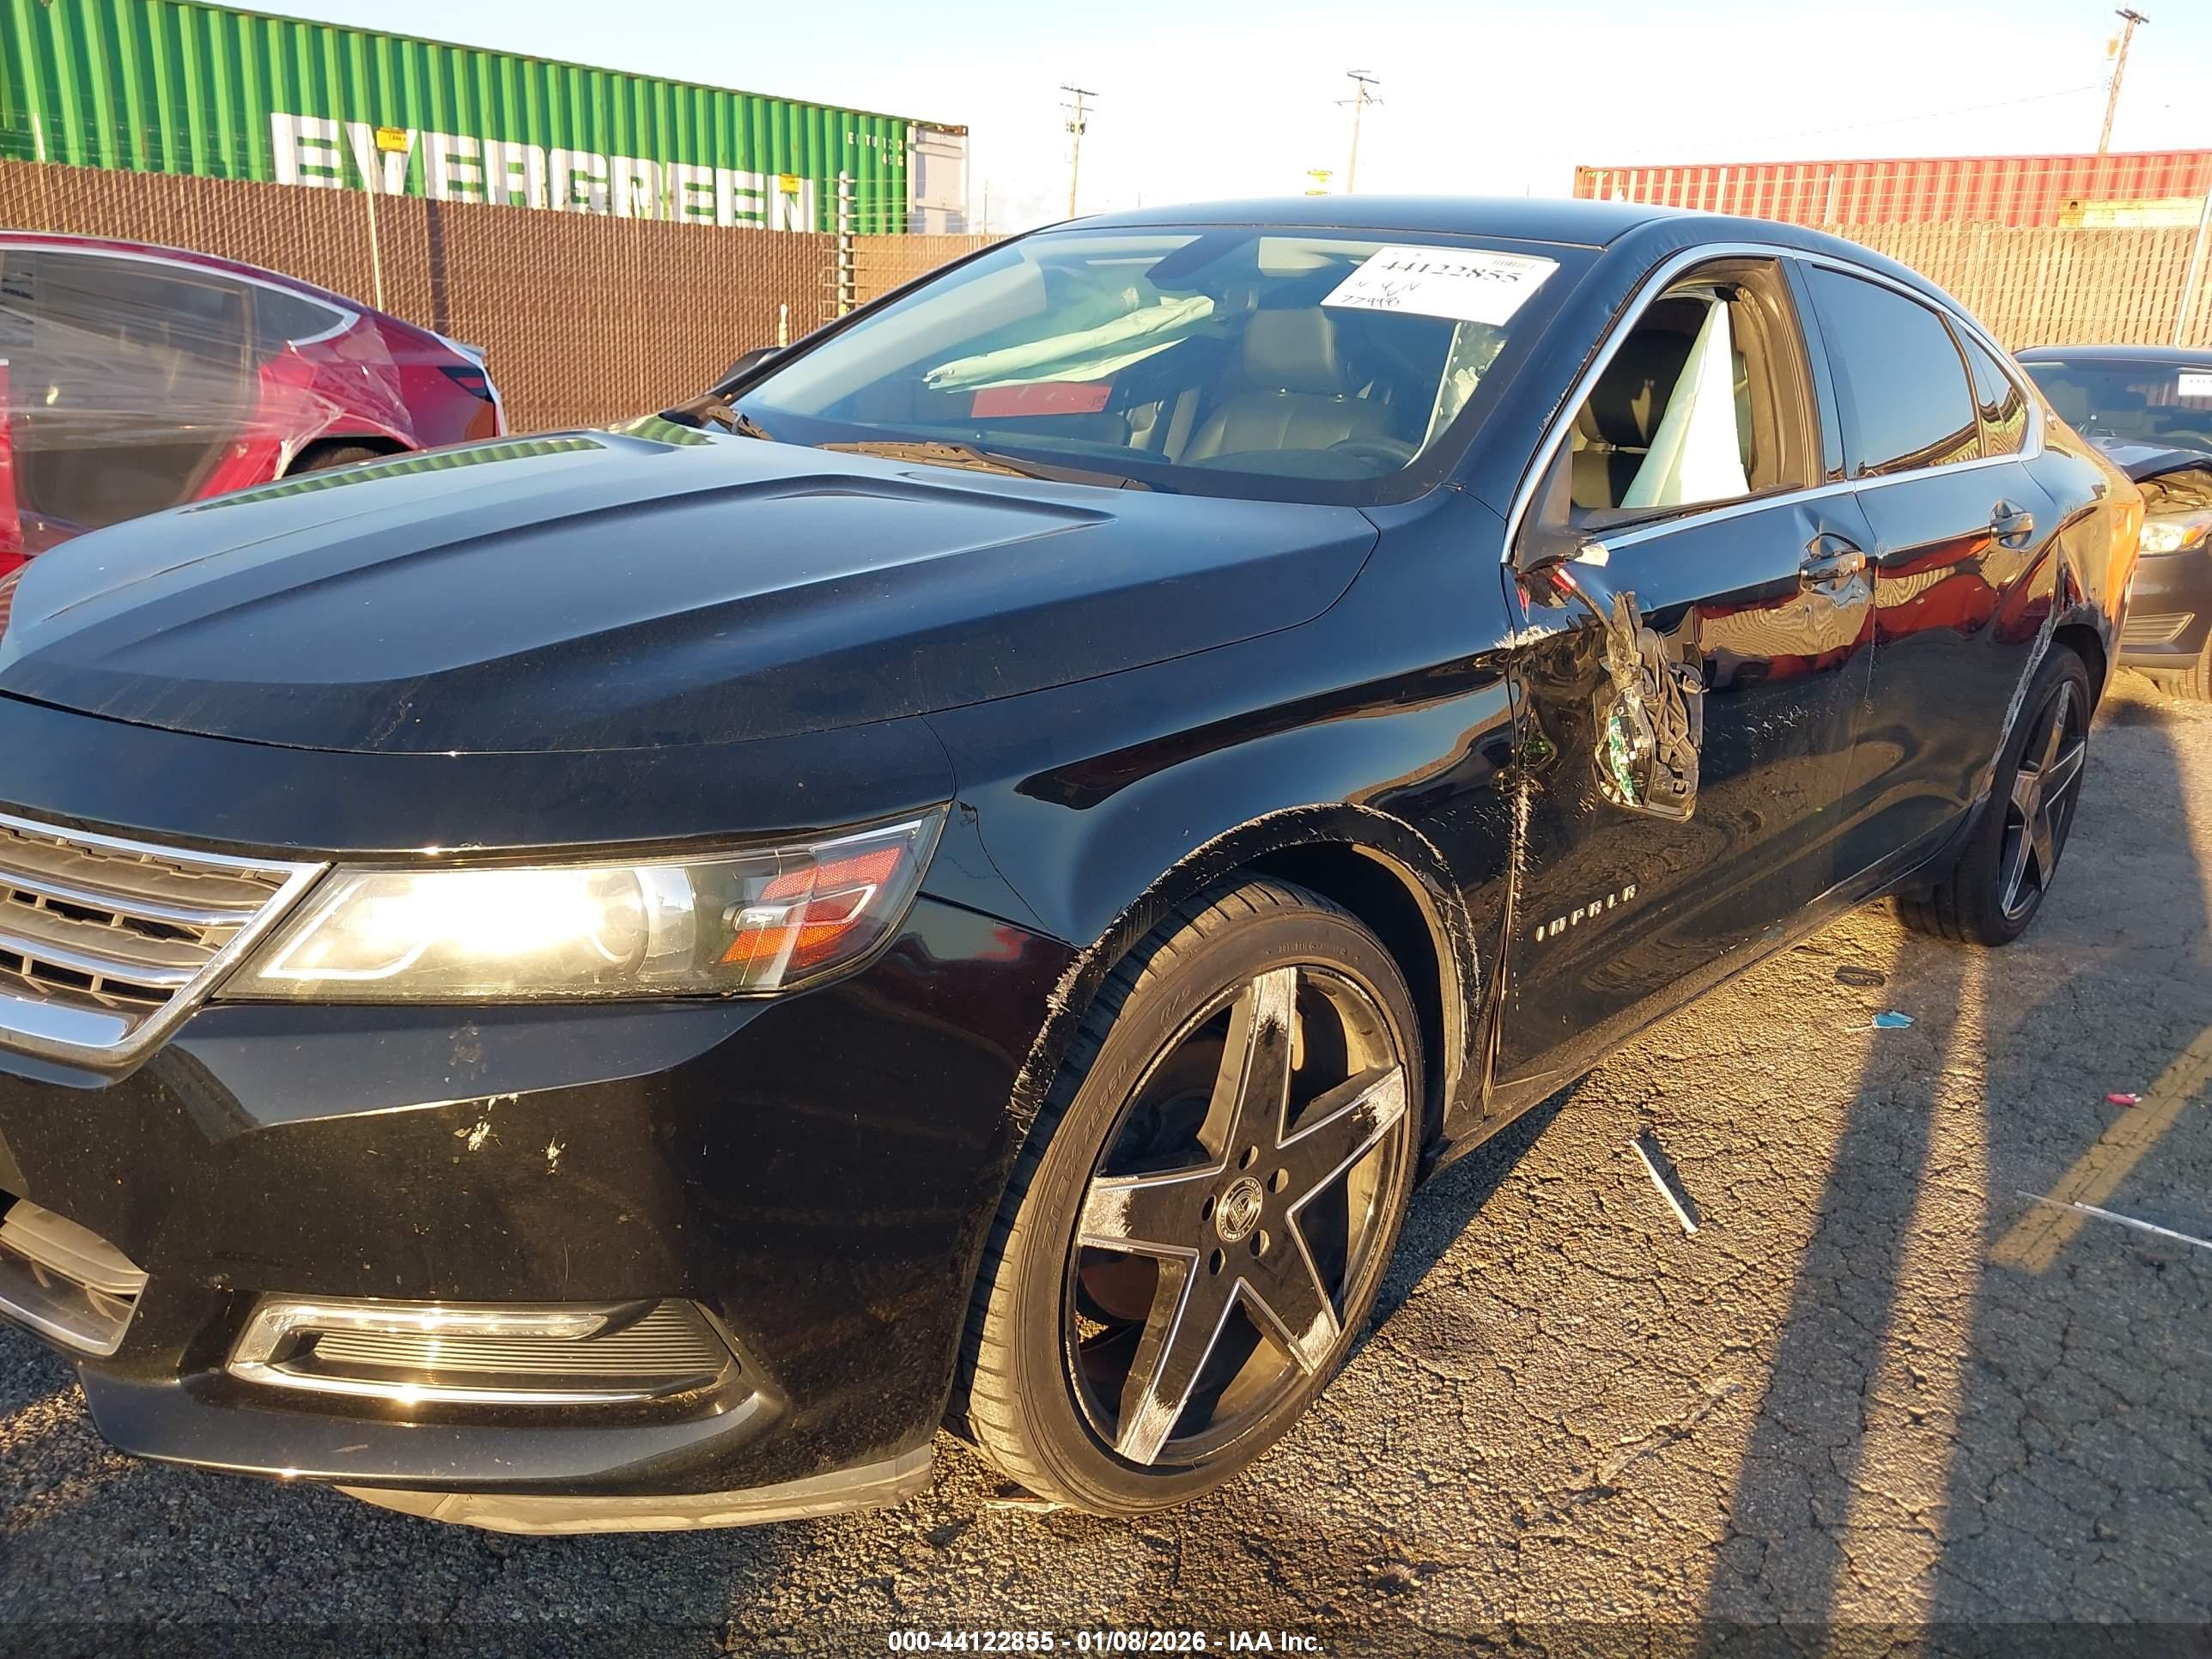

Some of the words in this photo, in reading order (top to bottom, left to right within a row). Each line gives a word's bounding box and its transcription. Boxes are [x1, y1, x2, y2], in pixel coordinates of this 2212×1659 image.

[270, 112, 814, 234] EVERGREEN
[1381, 260, 1522, 283] 44122855
[1535, 884, 1637, 942] IMPALA
